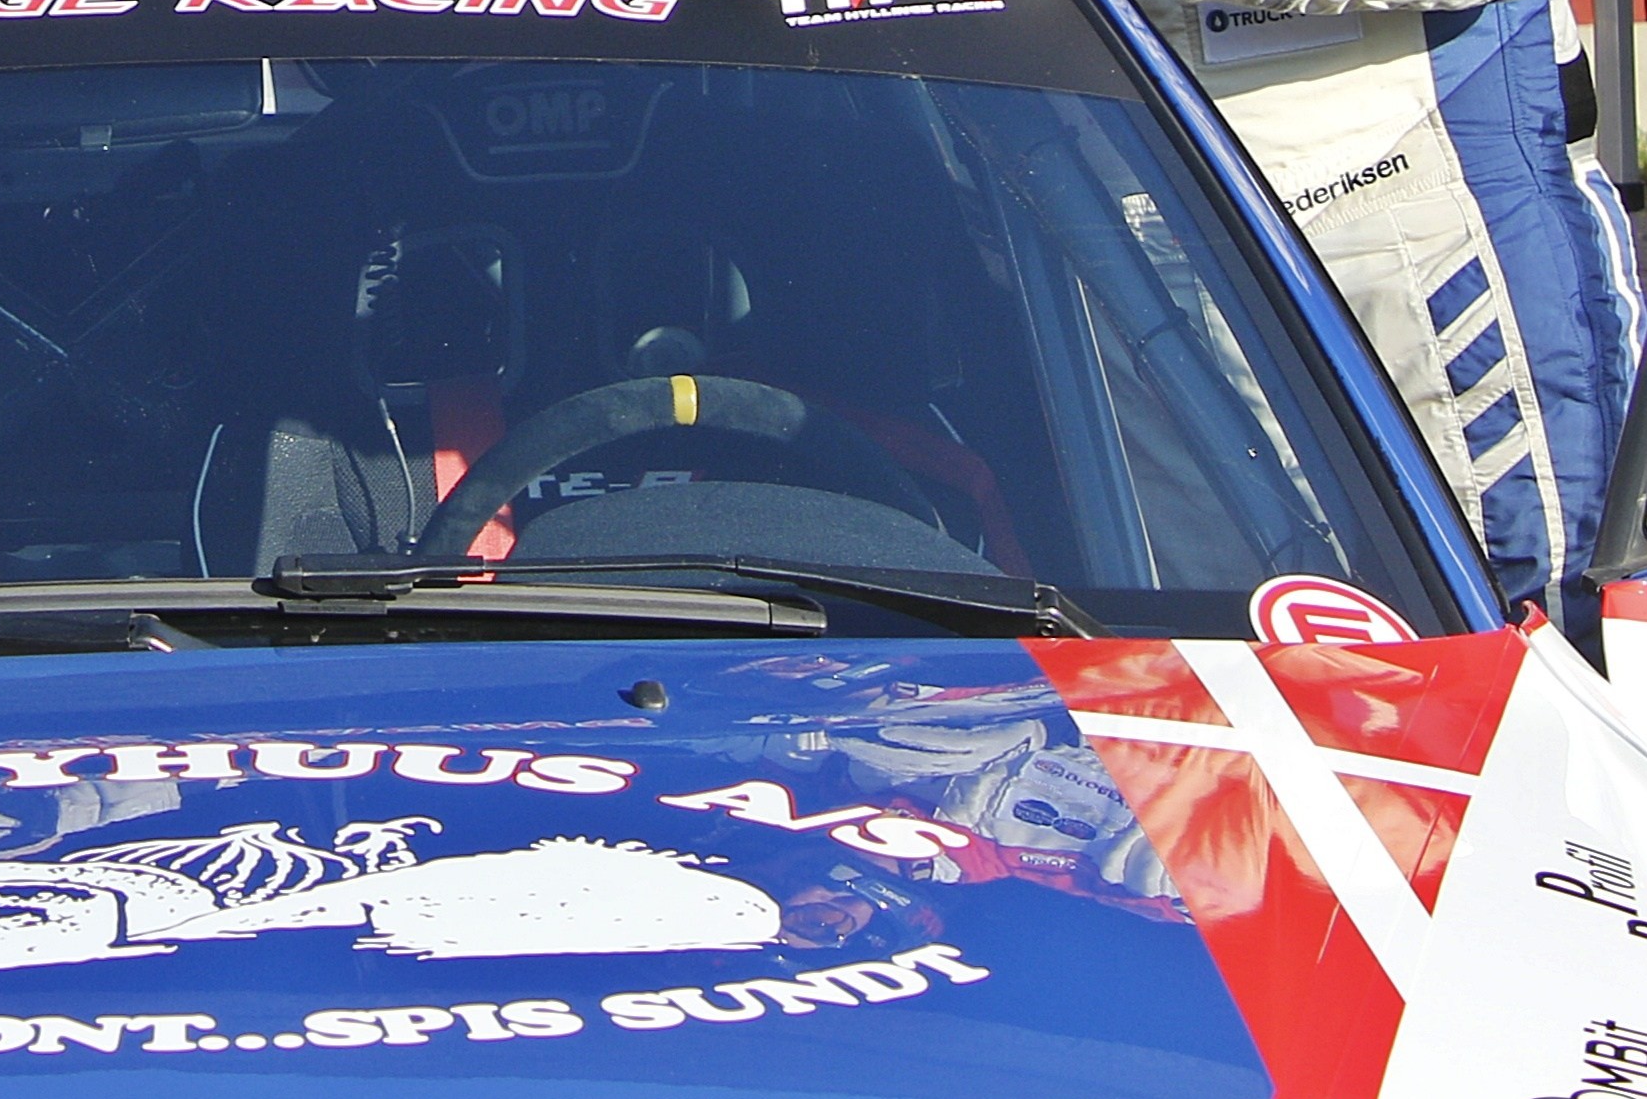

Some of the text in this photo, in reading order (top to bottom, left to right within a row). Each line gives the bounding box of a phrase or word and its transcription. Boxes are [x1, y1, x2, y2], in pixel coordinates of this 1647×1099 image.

[785, 0, 1006, 27] TEAM HYLLINGE RACING
[486, 89, 607, 137] OMP
[1282, 152, 1410, 216] ederiksen
[1535, 840, 1638, 916] Profil
[601, 944, 991, 1033] SUNDT
